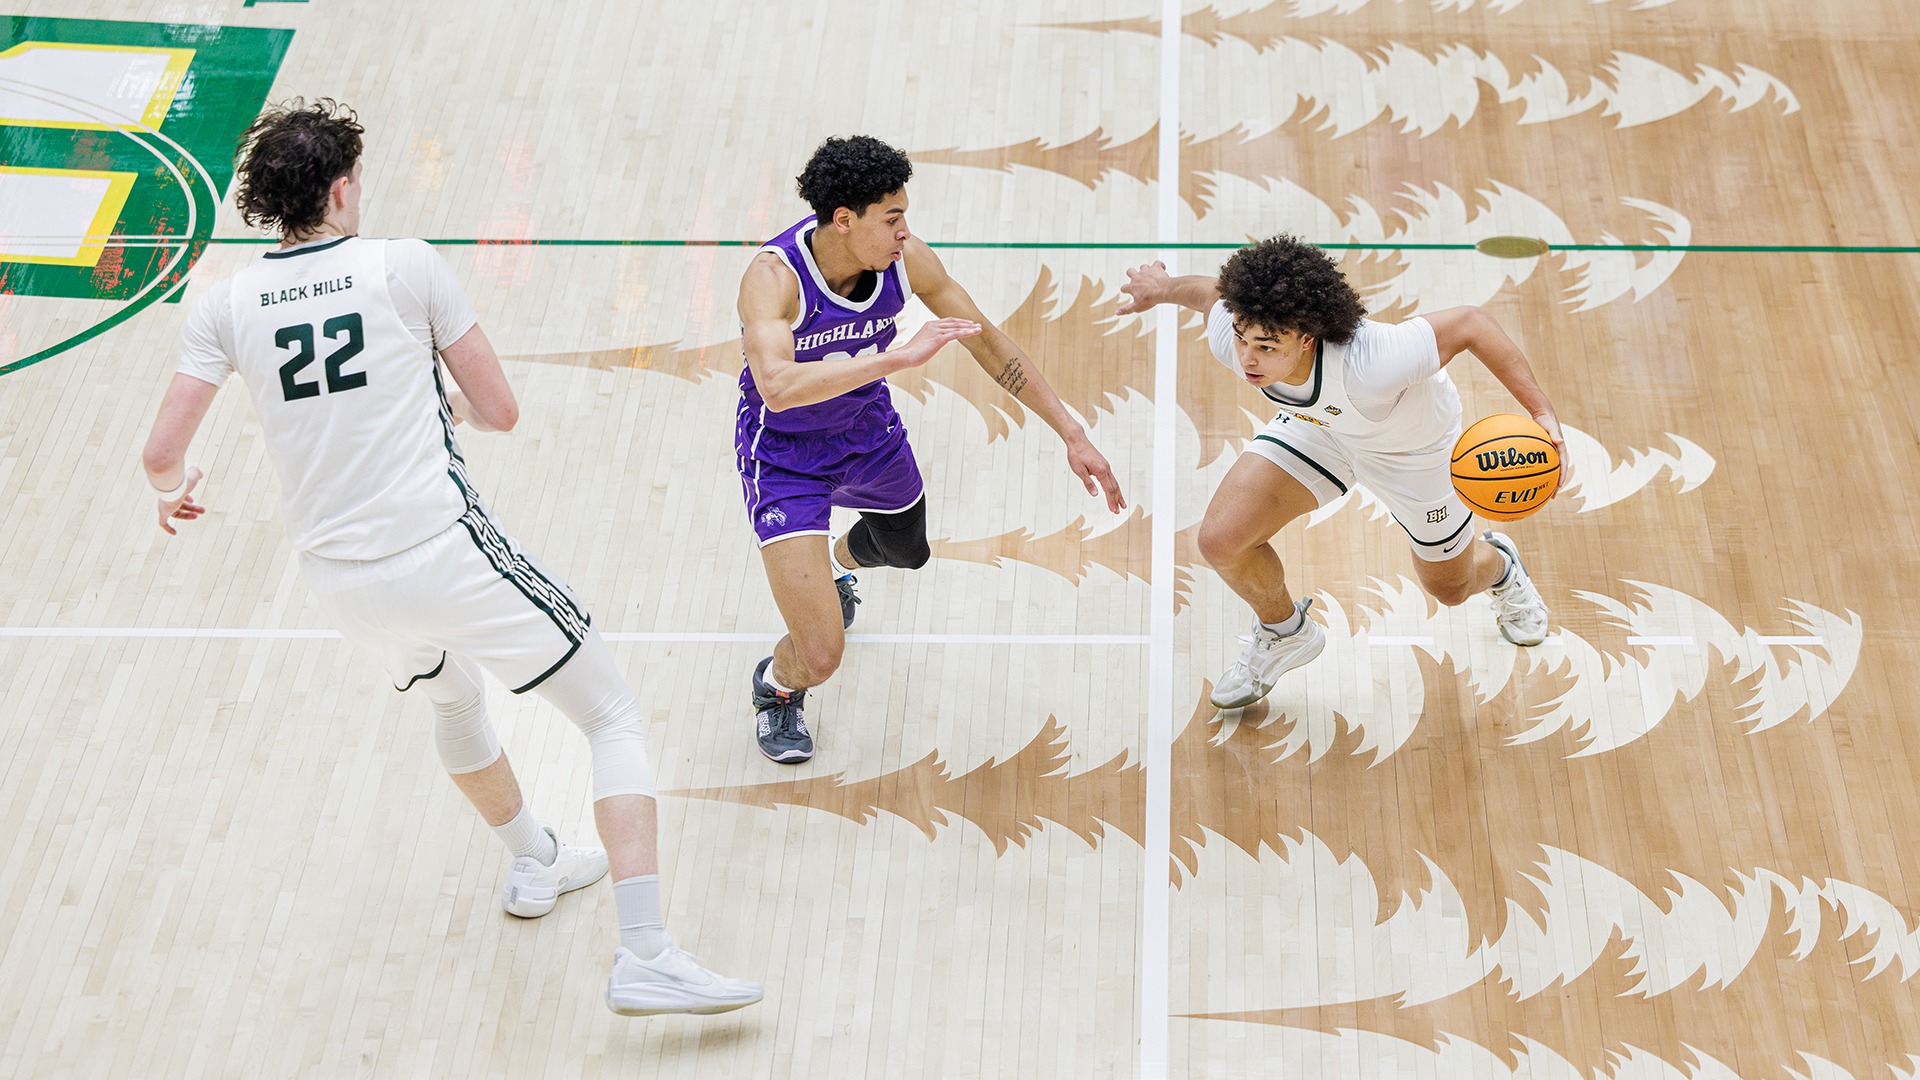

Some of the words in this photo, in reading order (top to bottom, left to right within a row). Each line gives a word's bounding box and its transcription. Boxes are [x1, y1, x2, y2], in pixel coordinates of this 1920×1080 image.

[260, 286, 308, 307] BLACK
[313, 276, 353, 297] HILLS
[275, 312, 367, 402] 22
[1475, 447, 1548, 472] Wilson
[1494, 487, 1538, 504] EVO
[1426, 505, 1447, 523] BH
